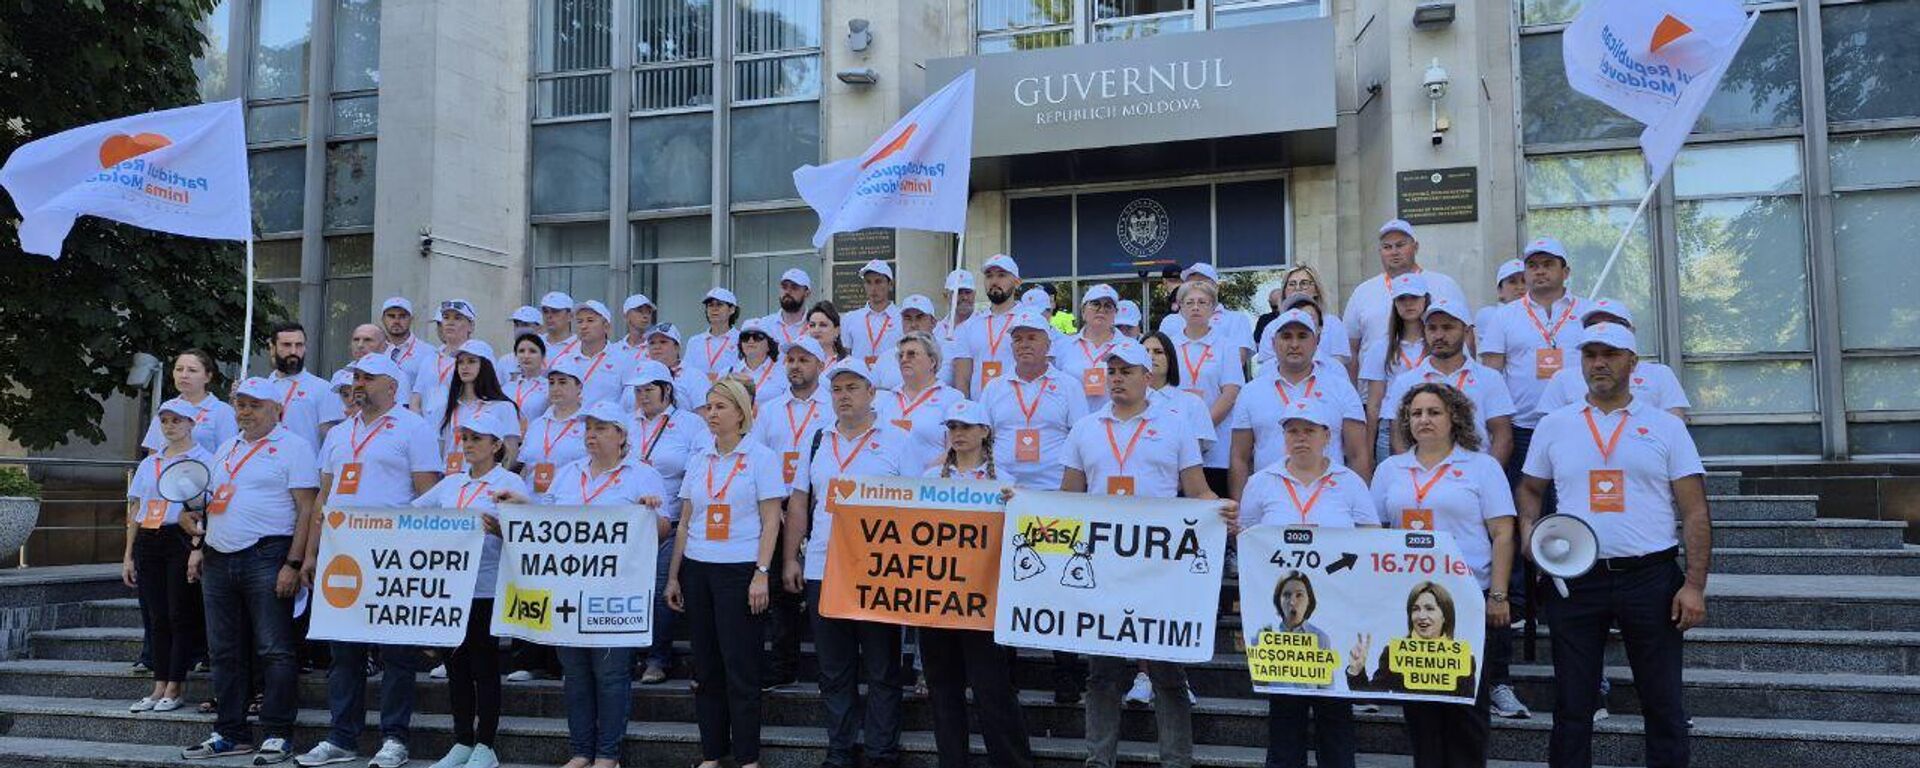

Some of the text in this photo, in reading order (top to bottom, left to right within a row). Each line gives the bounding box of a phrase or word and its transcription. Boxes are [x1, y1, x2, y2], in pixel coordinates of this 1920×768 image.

[1014, 58, 1233, 107] GUVERNUL
[1036, 97, 1202, 124] REPUBLICII MOLDOVA
[860, 482, 1006, 506] Inima Moldove
[348, 513, 476, 531] Inima Moldovei
[508, 520, 628, 544] ГАЗОВАЯ
[860, 518, 988, 549] VA OPRI
[1087, 517, 1201, 561] FURĂ
[1286, 532, 1311, 542] 2020
[1408, 536, 1433, 546] 2025
[371, 548, 470, 571] VA OPRI
[521, 553, 618, 578] МАФИЯ
[867, 551, 966, 582] JAFUL
[1270, 549, 1322, 570] 4.70
[1370, 552, 1436, 575] 16.70
[375, 577, 452, 599] JAFUL
[588, 595, 644, 614] EGC
[856, 584, 988, 618] TARIFAR
[365, 604, 463, 628] TARIFAR
[587, 616, 644, 626] ENERGOCOM
[1011, 606, 1202, 648] NOI PLĂTIM!
[1264, 632, 1312, 647] CEREM
[1398, 639, 1461, 655] ASTEA-S
[1254, 663, 1326, 679] TARIFULUI!
[1396, 656, 1461, 671] VREMURI
[1411, 673, 1450, 686] BUNE
